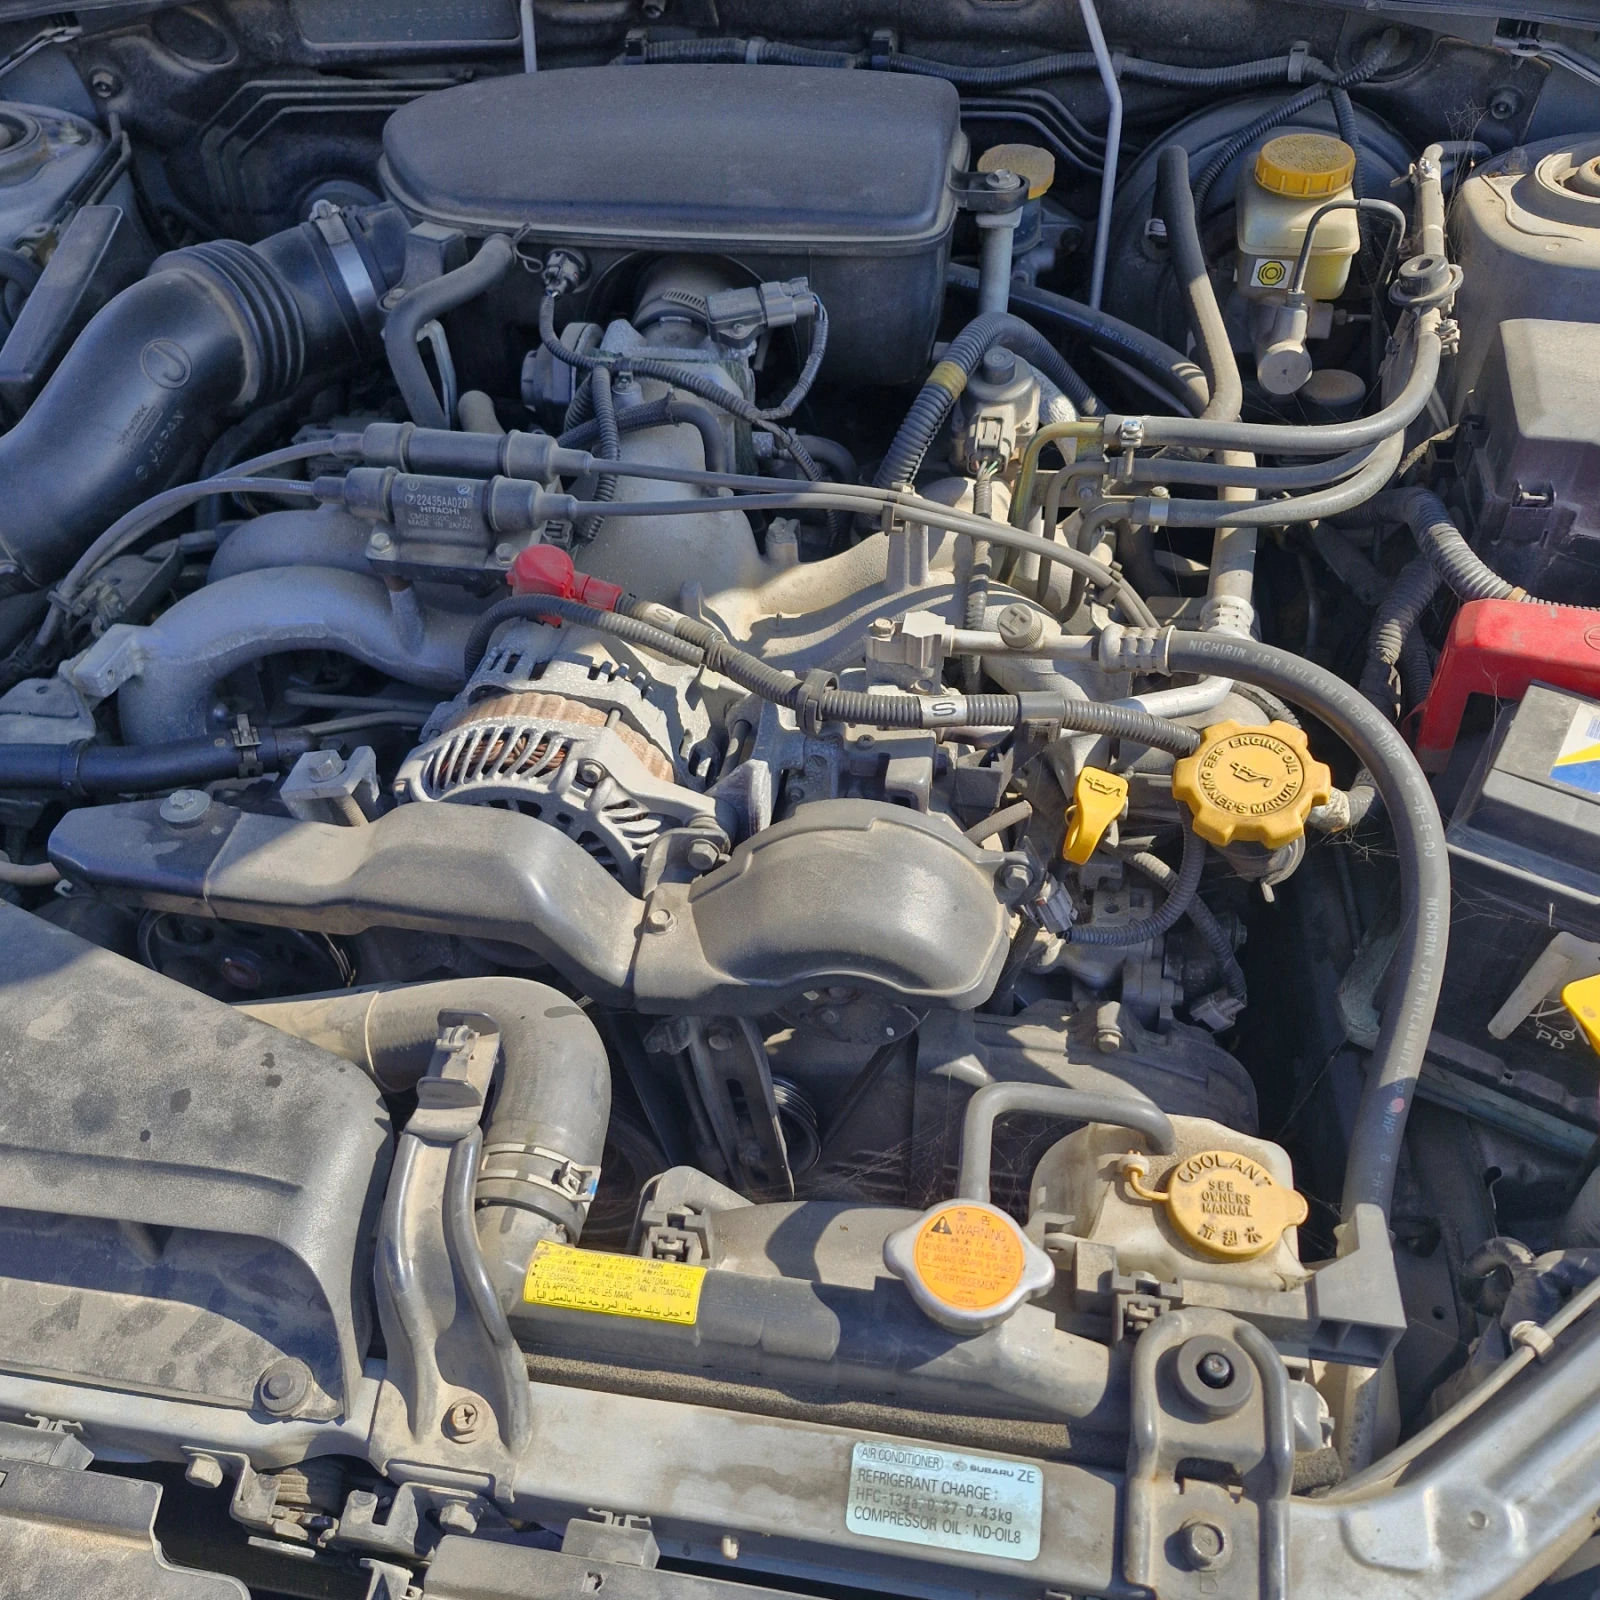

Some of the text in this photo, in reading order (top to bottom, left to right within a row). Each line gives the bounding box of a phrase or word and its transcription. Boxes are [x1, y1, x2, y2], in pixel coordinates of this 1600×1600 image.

[420, 506, 460, 515] HITACHI
[408, 520, 431, 528] MADE
[448, 522, 473, 530] JAPAN
[1189, 639, 1247, 658] NICHIRIN
[1252, 652, 1281, 671] JPN
[932, 702, 956, 717] S
[1229, 736, 1298, 774] ENGINE OIL
[1202, 747, 1298, 814] SEE OWNER'S MANUAL
[1422, 897, 1439, 963] NICHIRIN
[1419, 965, 1433, 990] JPN
[1536, 1029, 1566, 1050] Pb
[1177, 1153, 1272, 1187] COOLANT
[1208, 1179, 1234, 1192] SEE
[1201, 1191, 1252, 1205] OWNERS
[1202, 1202, 1252, 1218] MANUAL
[956, 1224, 1006, 1242] WARNING
[577, 1250, 611, 1262] CAUTION
[614, 1255, 664, 1270] ATTENTION
[923, 1242, 1016, 1262] NEVER OPEN WHEN HOT
[558, 1265, 580, 1276] HANDS
[602, 1270, 615, 1280] FAN
[617, 1272, 641, 1283] STARTS
[643, 1275, 694, 1288] AUTOMATICALLY
[934, 1272, 1000, 1290] AVERTISSEMENT
[588, 1287, 599, 1296] PAS
[602, 1288, 612, 1297] LES
[614, 1290, 632, 1300] MAINS
[861, 1447, 940, 1469] AIR CONDITIONER
[858, 1468, 939, 1490] REFRIGERANT
[969, 1464, 1036, 1484] SUBARU ZE
[854, 1506, 938, 1532] COMPRESSOR
[942, 1520, 962, 1536] OIL
[973, 1524, 1022, 1545] ND-OIL8
